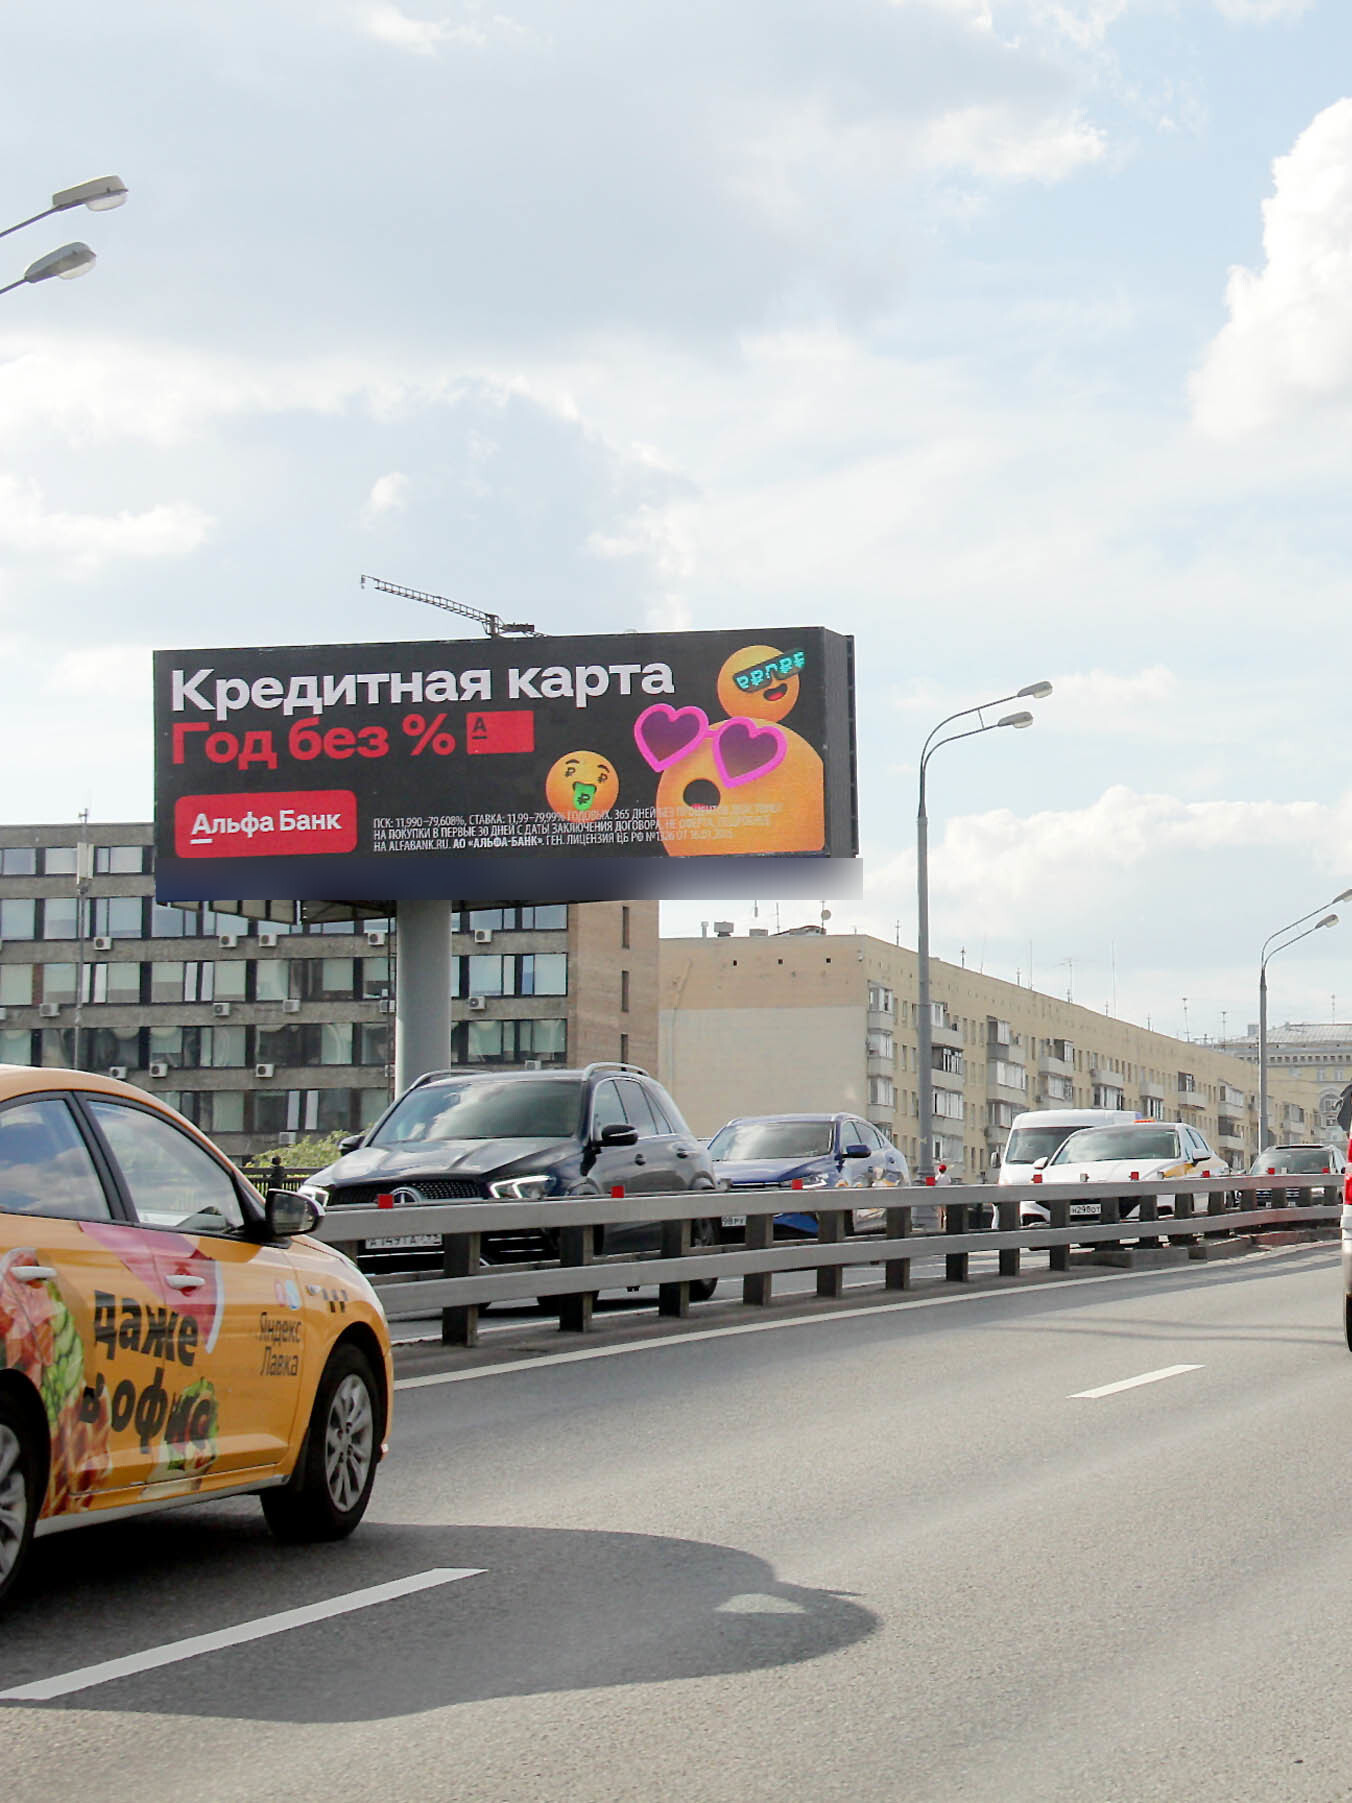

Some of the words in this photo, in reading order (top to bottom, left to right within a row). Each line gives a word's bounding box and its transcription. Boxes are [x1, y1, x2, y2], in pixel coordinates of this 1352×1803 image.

[172, 669, 492, 721] Кредитная
[508, 662, 675, 708] карта
[172, 721, 278, 770] Год
[288, 716, 390, 761] без
[402, 713, 456, 756] %
[190, 811, 275, 843] Альфа
[279, 809, 343, 831] Банк
[373, 817, 393, 829] ПСК:
[469, 813, 505, 825] СТАВКА:
[614, 809, 630, 820] 365
[632, 806, 656, 820] ДНЕЙ
[374, 829, 387, 840] НА
[388, 827, 431, 840] ПОКУПКИ
[432, 827, 440, 839] В
[441, 825, 477, 838] ПЕРВЫЕ
[478, 825, 489, 836] 30
[491, 823, 515, 837] ДНЕЙ
[516, 824, 523, 835] С
[525, 823, 550, 836] ДАТЫ
[551, 821, 613, 834] ЗАКЛЮЧЕНИЯ
[374, 841, 387, 852] НА
[453, 838, 465, 849] АО
[546, 834, 565, 846] ГЕН.
[566, 832, 614, 846] ЛИЦЕНЗИЯ
[616, 831, 629, 844] ЦБ
[631, 830, 644, 842] РФ
[94, 1289, 199, 1367] Даже
[258, 1311, 302, 1345] Яндекс
[259, 1346, 299, 1376] Лавка
